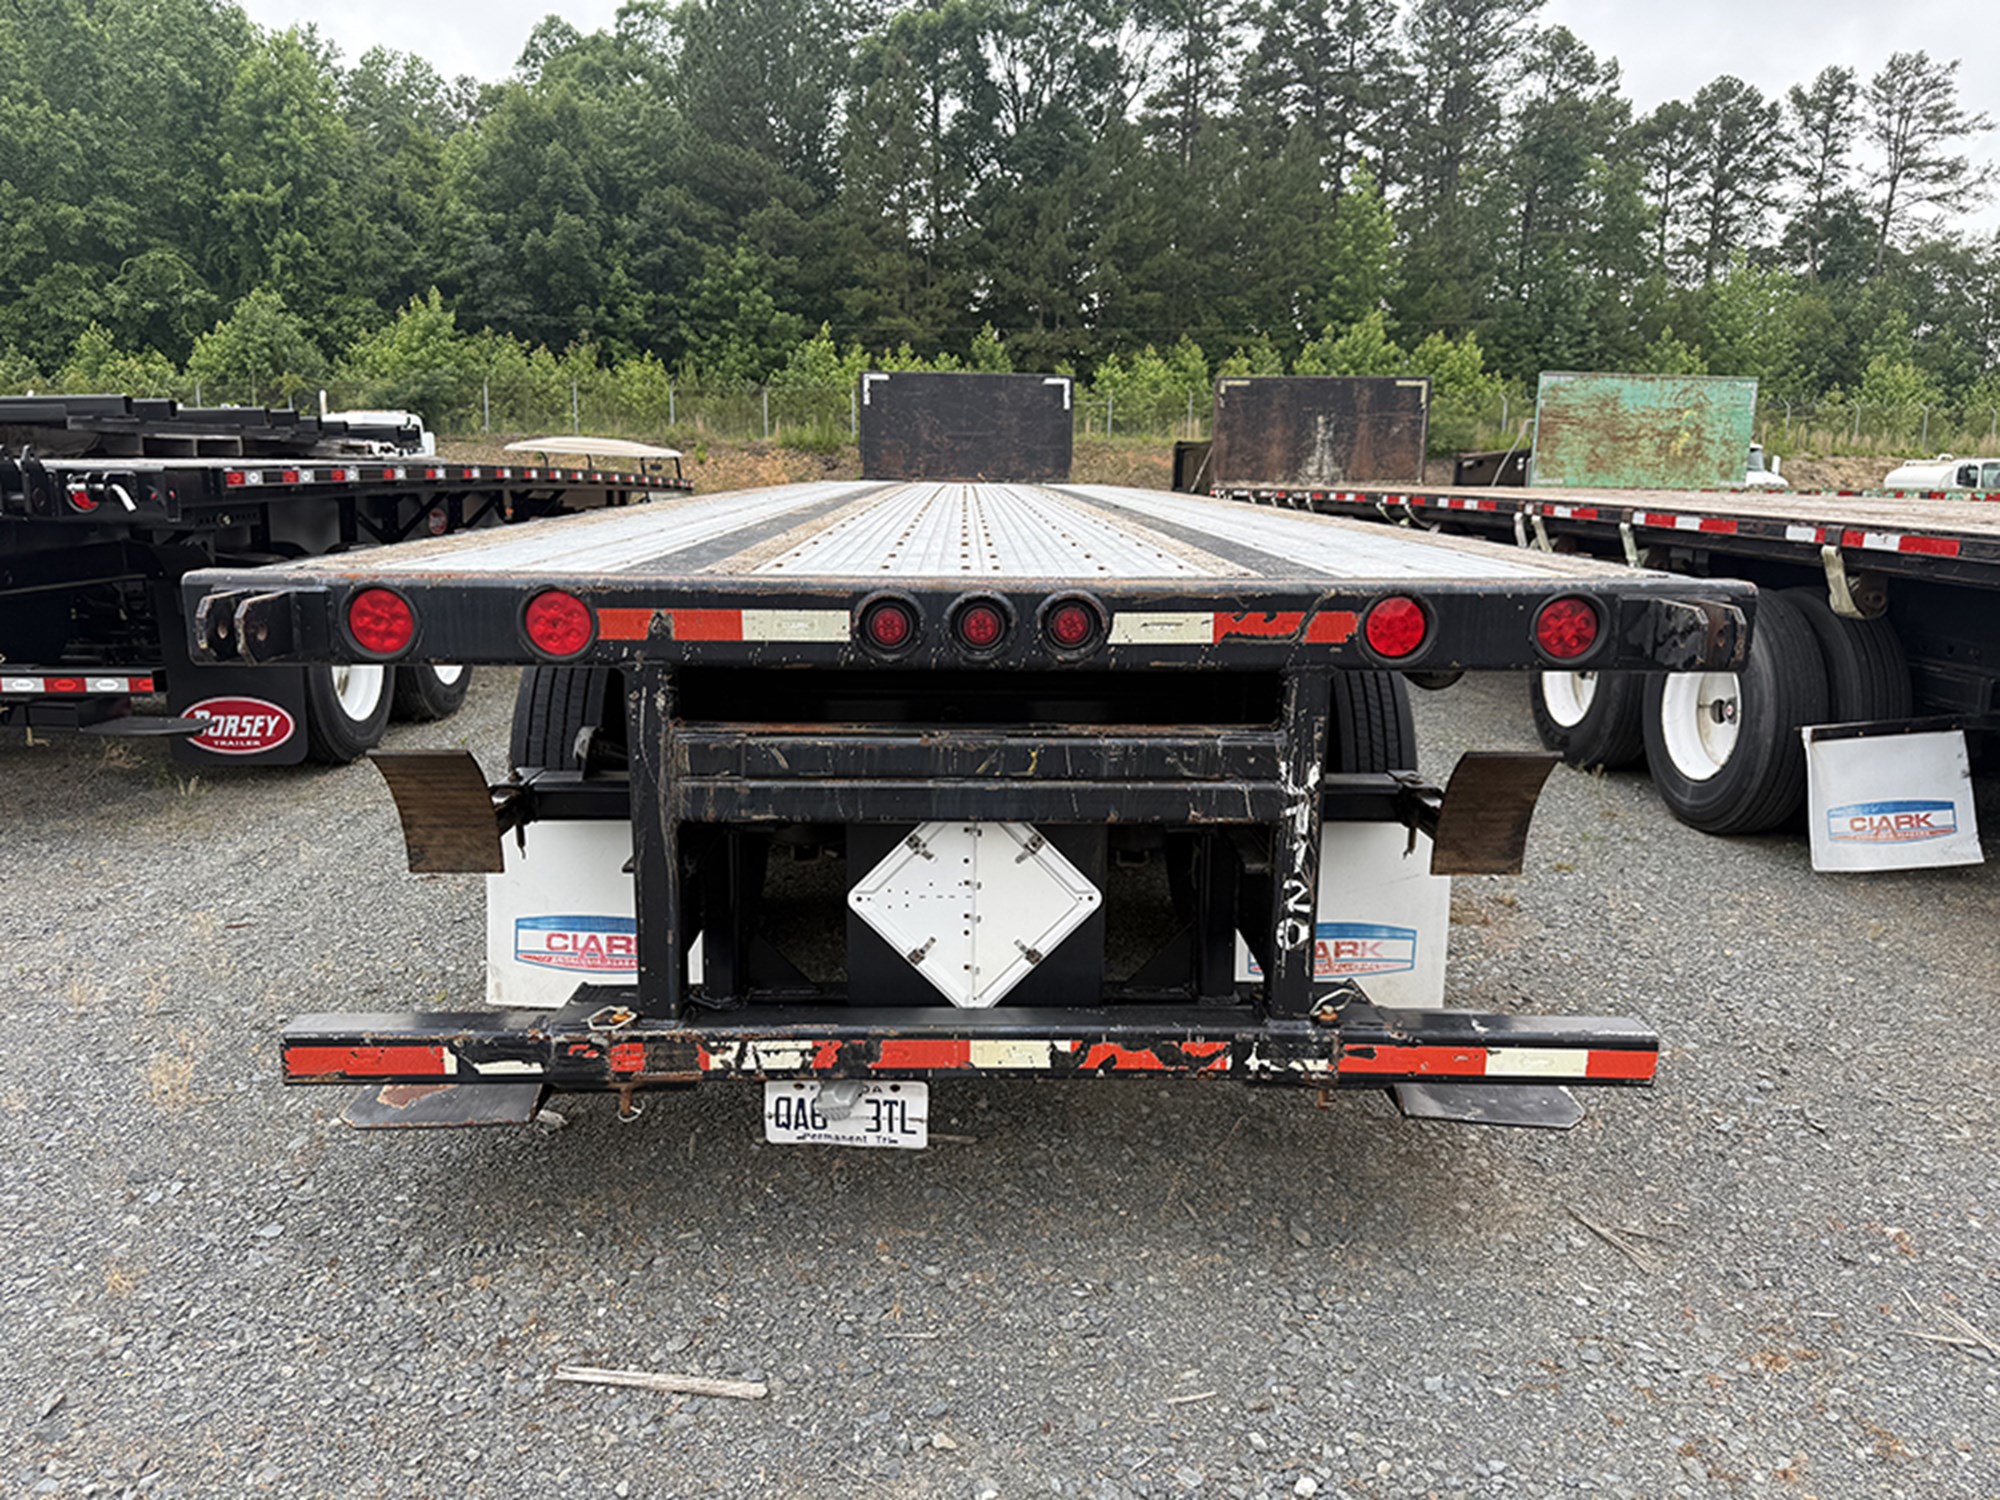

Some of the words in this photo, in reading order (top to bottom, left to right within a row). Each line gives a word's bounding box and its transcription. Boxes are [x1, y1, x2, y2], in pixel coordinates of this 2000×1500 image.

[1849, 813, 1935, 837] CLARK
[546, 932, 638, 962] CLAR
[1315, 941, 1384, 966] ARK
[865, 1099, 917, 1135] 3TL
